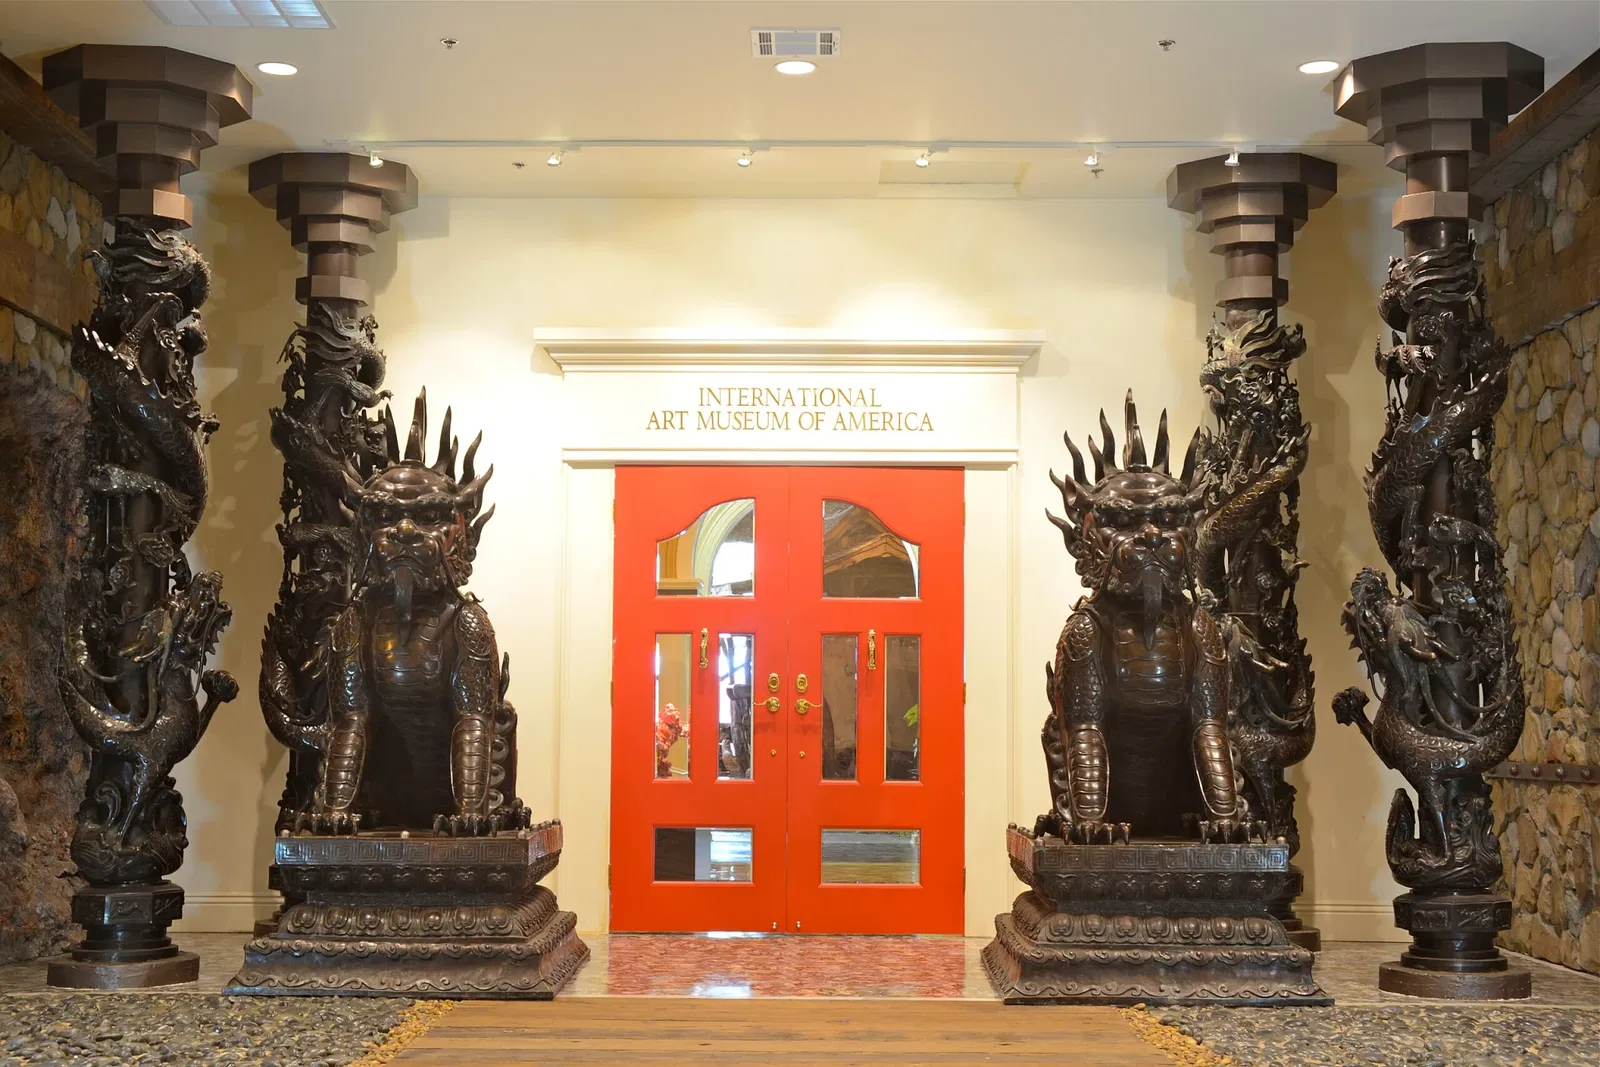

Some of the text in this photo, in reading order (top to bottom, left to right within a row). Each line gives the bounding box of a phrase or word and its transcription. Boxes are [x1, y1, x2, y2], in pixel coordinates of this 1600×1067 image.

[698, 387, 882, 407] INTERNATIONAL
[646, 410, 934, 431] ART MUSEUM OF AMERICA
